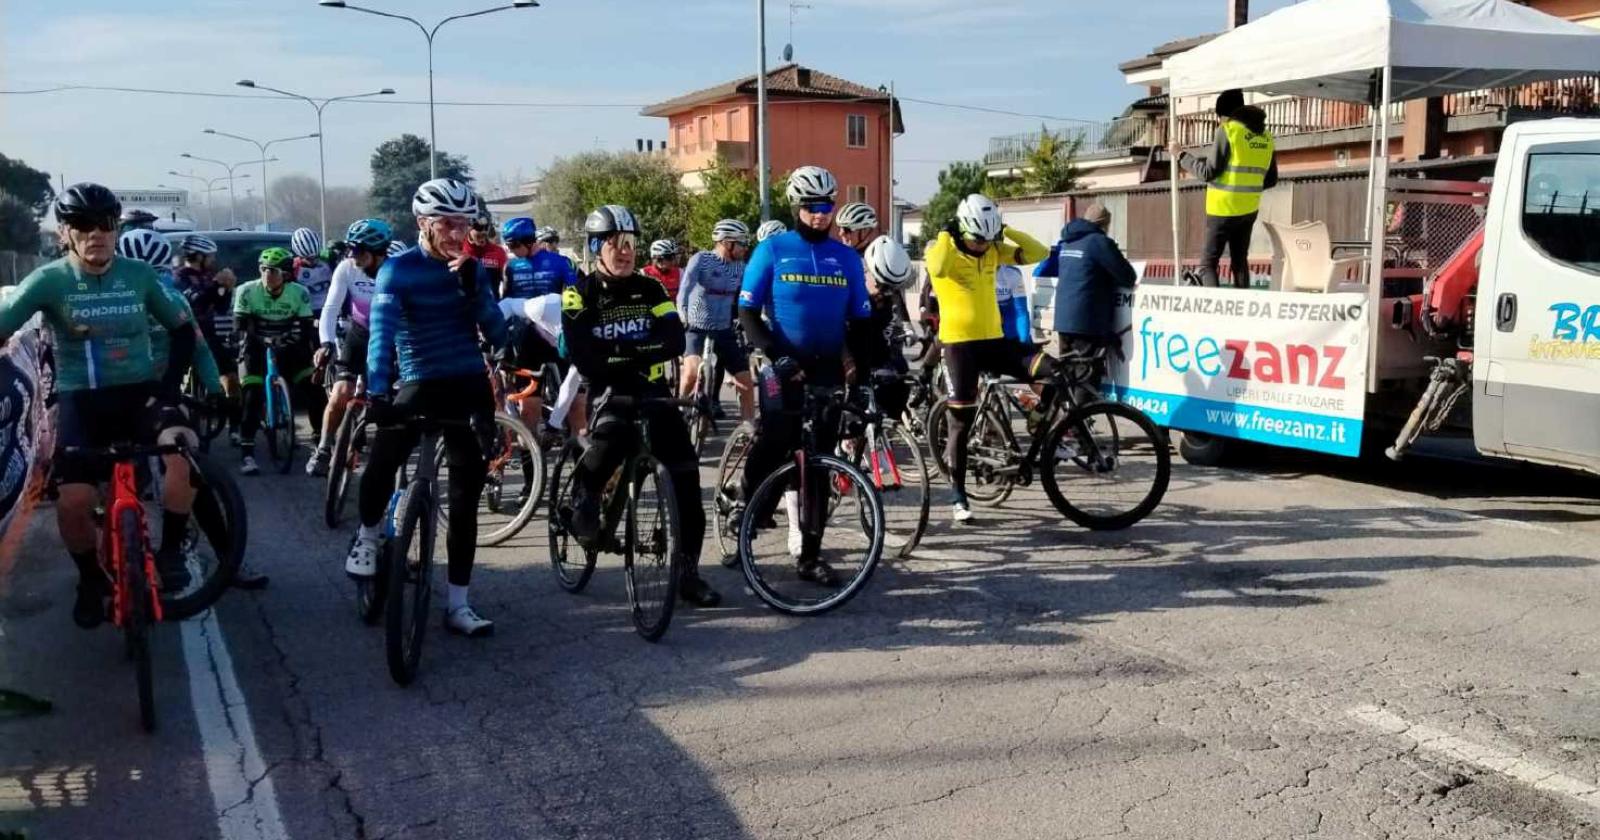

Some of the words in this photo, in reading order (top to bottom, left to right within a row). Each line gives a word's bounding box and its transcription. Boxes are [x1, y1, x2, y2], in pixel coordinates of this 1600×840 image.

[72, 303, 145, 319] FONDRIEST
[1139, 294, 1245, 317] ANTIZANZARE
[1247, 302, 1272, 319] DA
[1277, 302, 1363, 321] ESTERNO
[1225, 386, 1260, 402] LIBERI
[1262, 390, 1294, 404] DALLE
[1295, 394, 1345, 411] ZANZARE
[1205, 408, 1347, 443] www.freezanz.it
